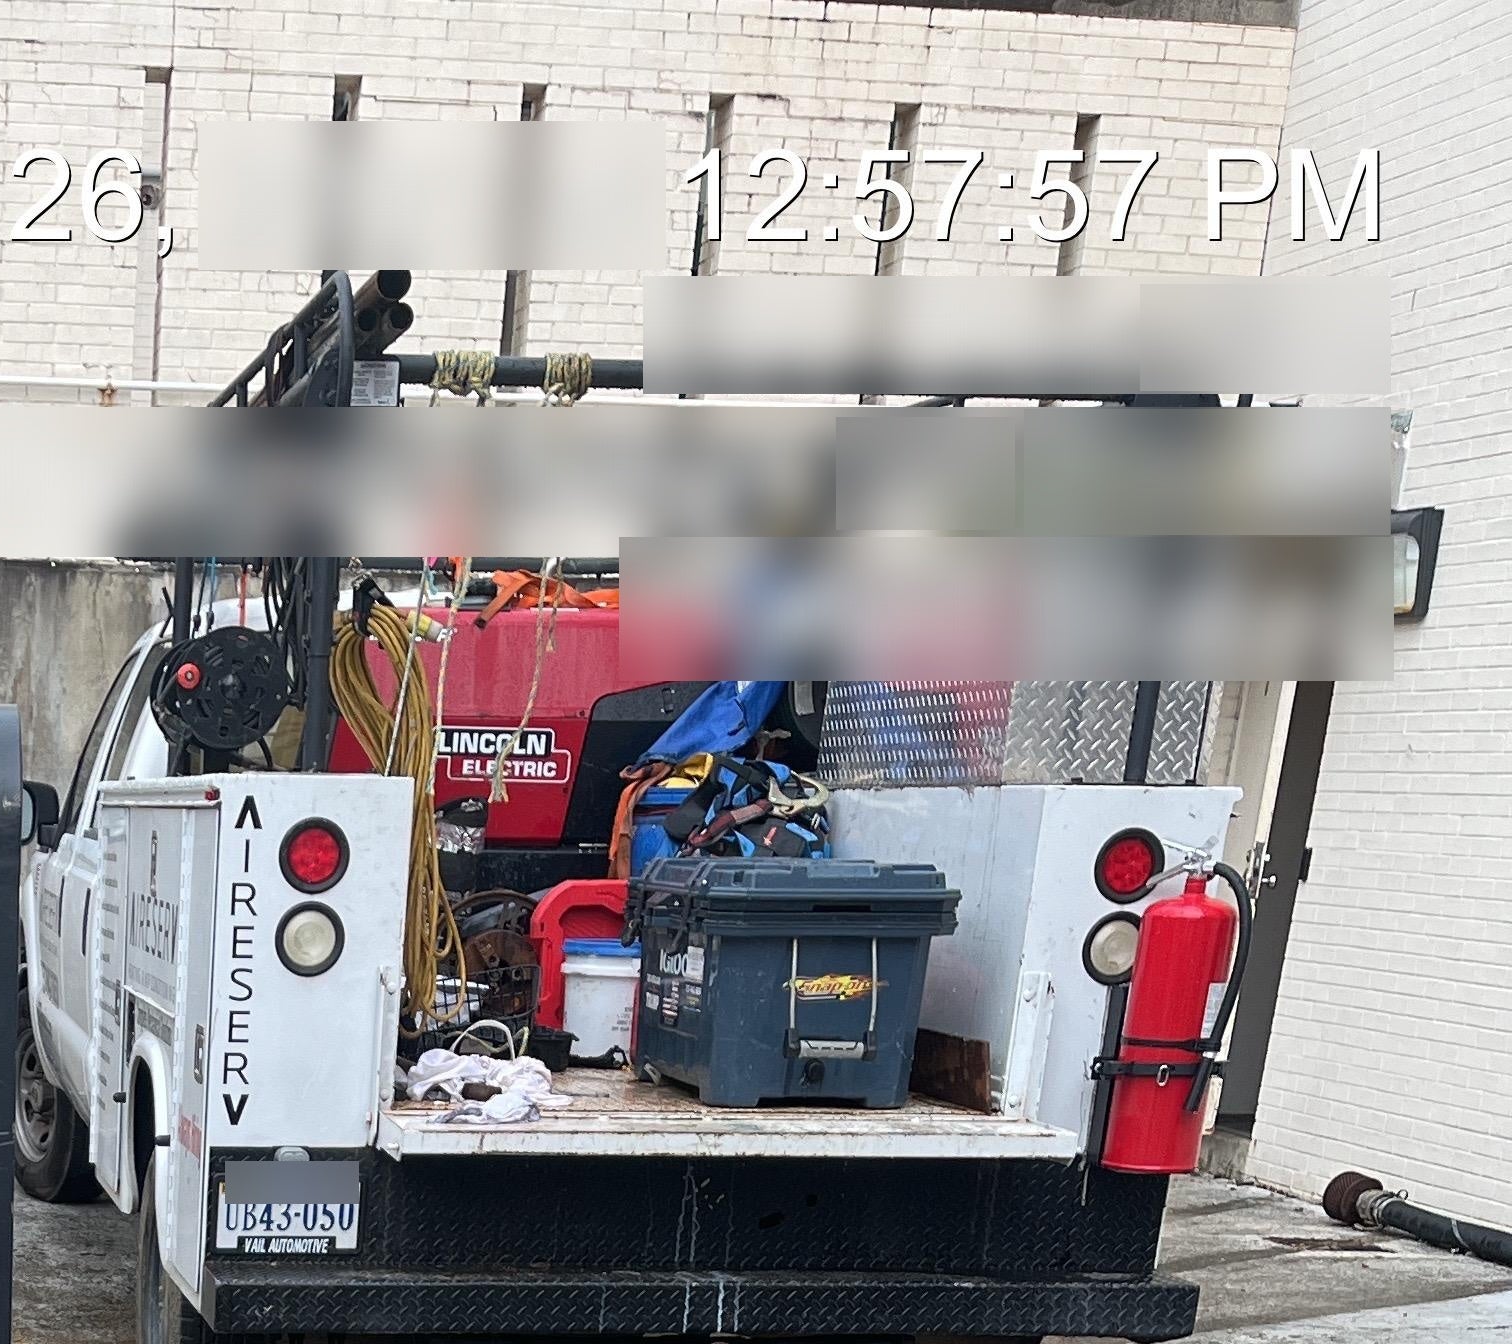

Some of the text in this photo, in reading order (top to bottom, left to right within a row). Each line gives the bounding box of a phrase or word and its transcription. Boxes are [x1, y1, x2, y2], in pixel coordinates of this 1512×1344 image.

[438, 731, 547, 756] LINCOLN
[462, 758, 558, 778] ELECTRIC
[244, 1237, 330, 1254] VAIL AUTOMOTIVE
